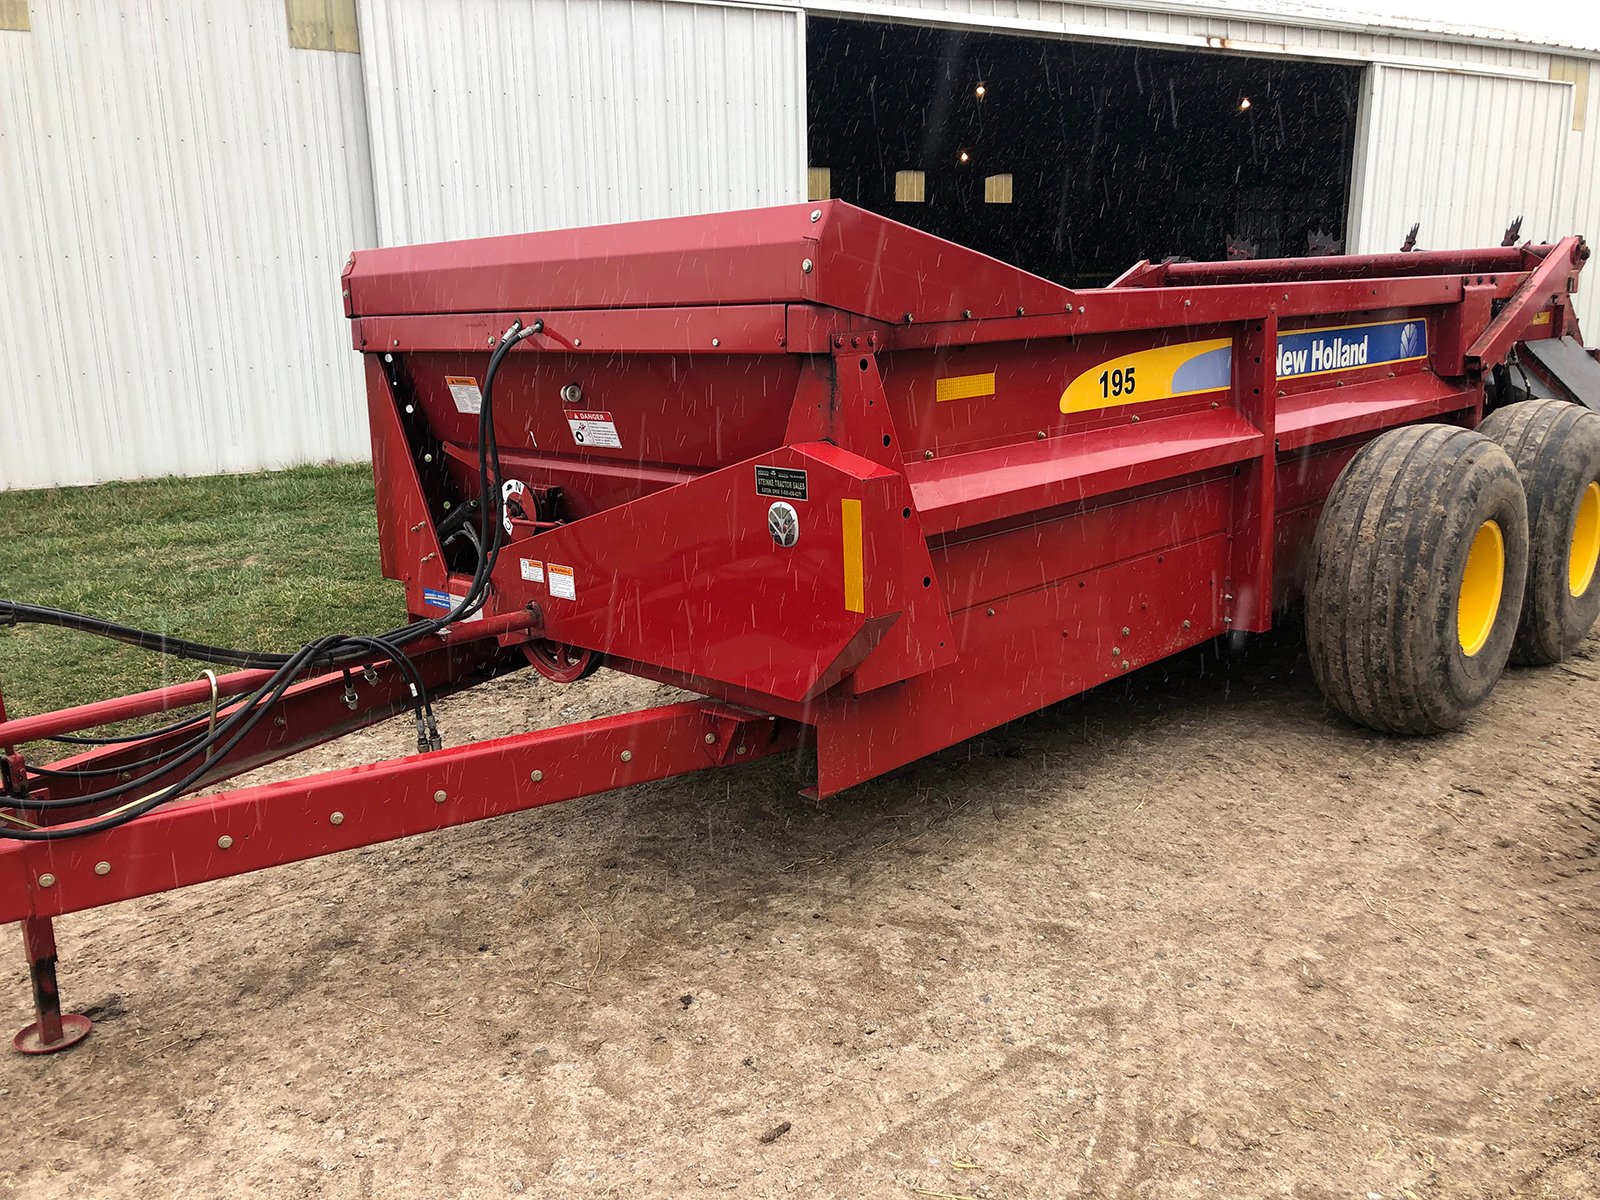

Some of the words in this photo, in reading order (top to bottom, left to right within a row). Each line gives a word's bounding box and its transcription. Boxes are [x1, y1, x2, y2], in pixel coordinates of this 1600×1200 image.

[1311, 334, 1369, 371] Holland
[1099, 367, 1136, 398] 195
[579, 413, 605, 421] DANGER
[793, 482, 805, 490] SALES
